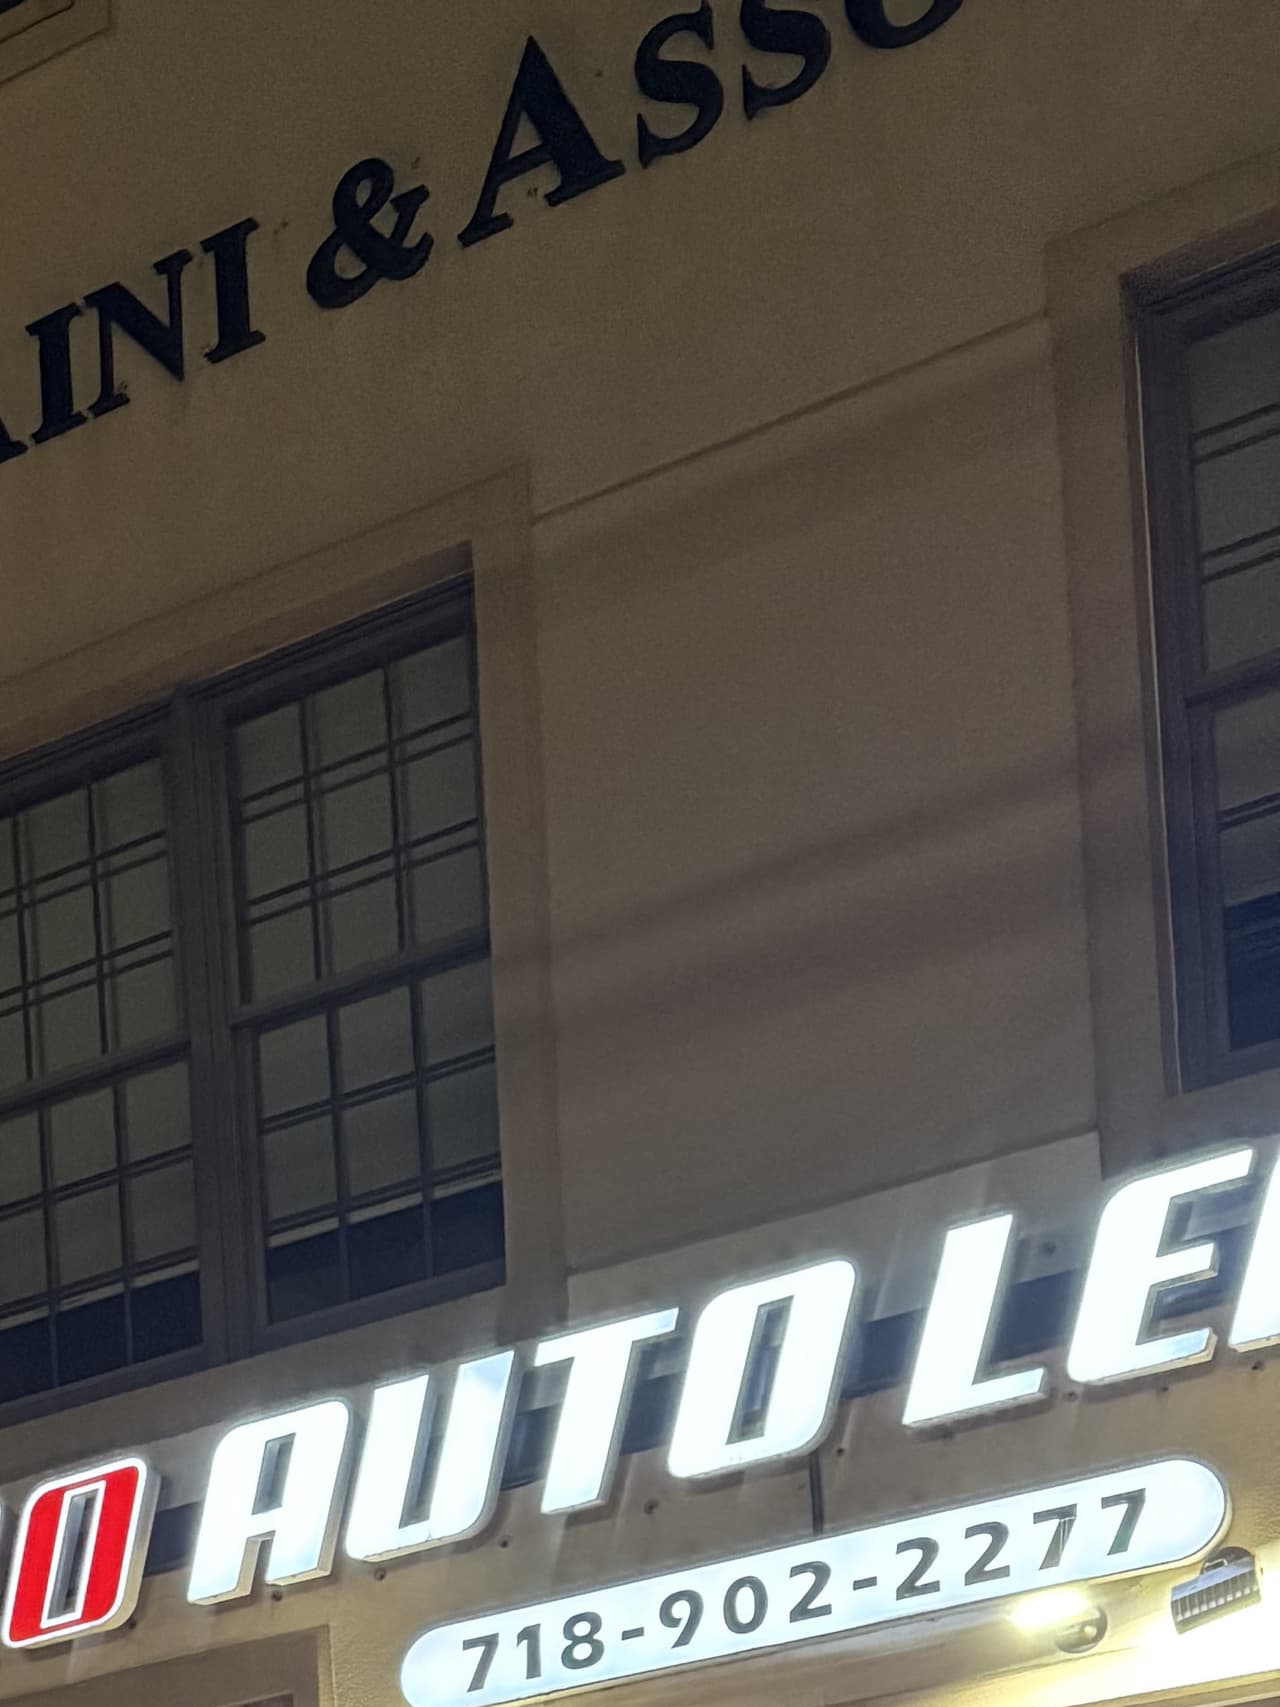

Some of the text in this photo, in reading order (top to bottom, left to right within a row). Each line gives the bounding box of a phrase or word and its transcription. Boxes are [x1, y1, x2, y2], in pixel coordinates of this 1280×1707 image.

[306, 157, 435, 309] &
[186, 1258, 860, 1606] AUTO
[901, 1146, 1280, 1428] LE
[461, 1488, 1147, 1694] 718-902-2277
